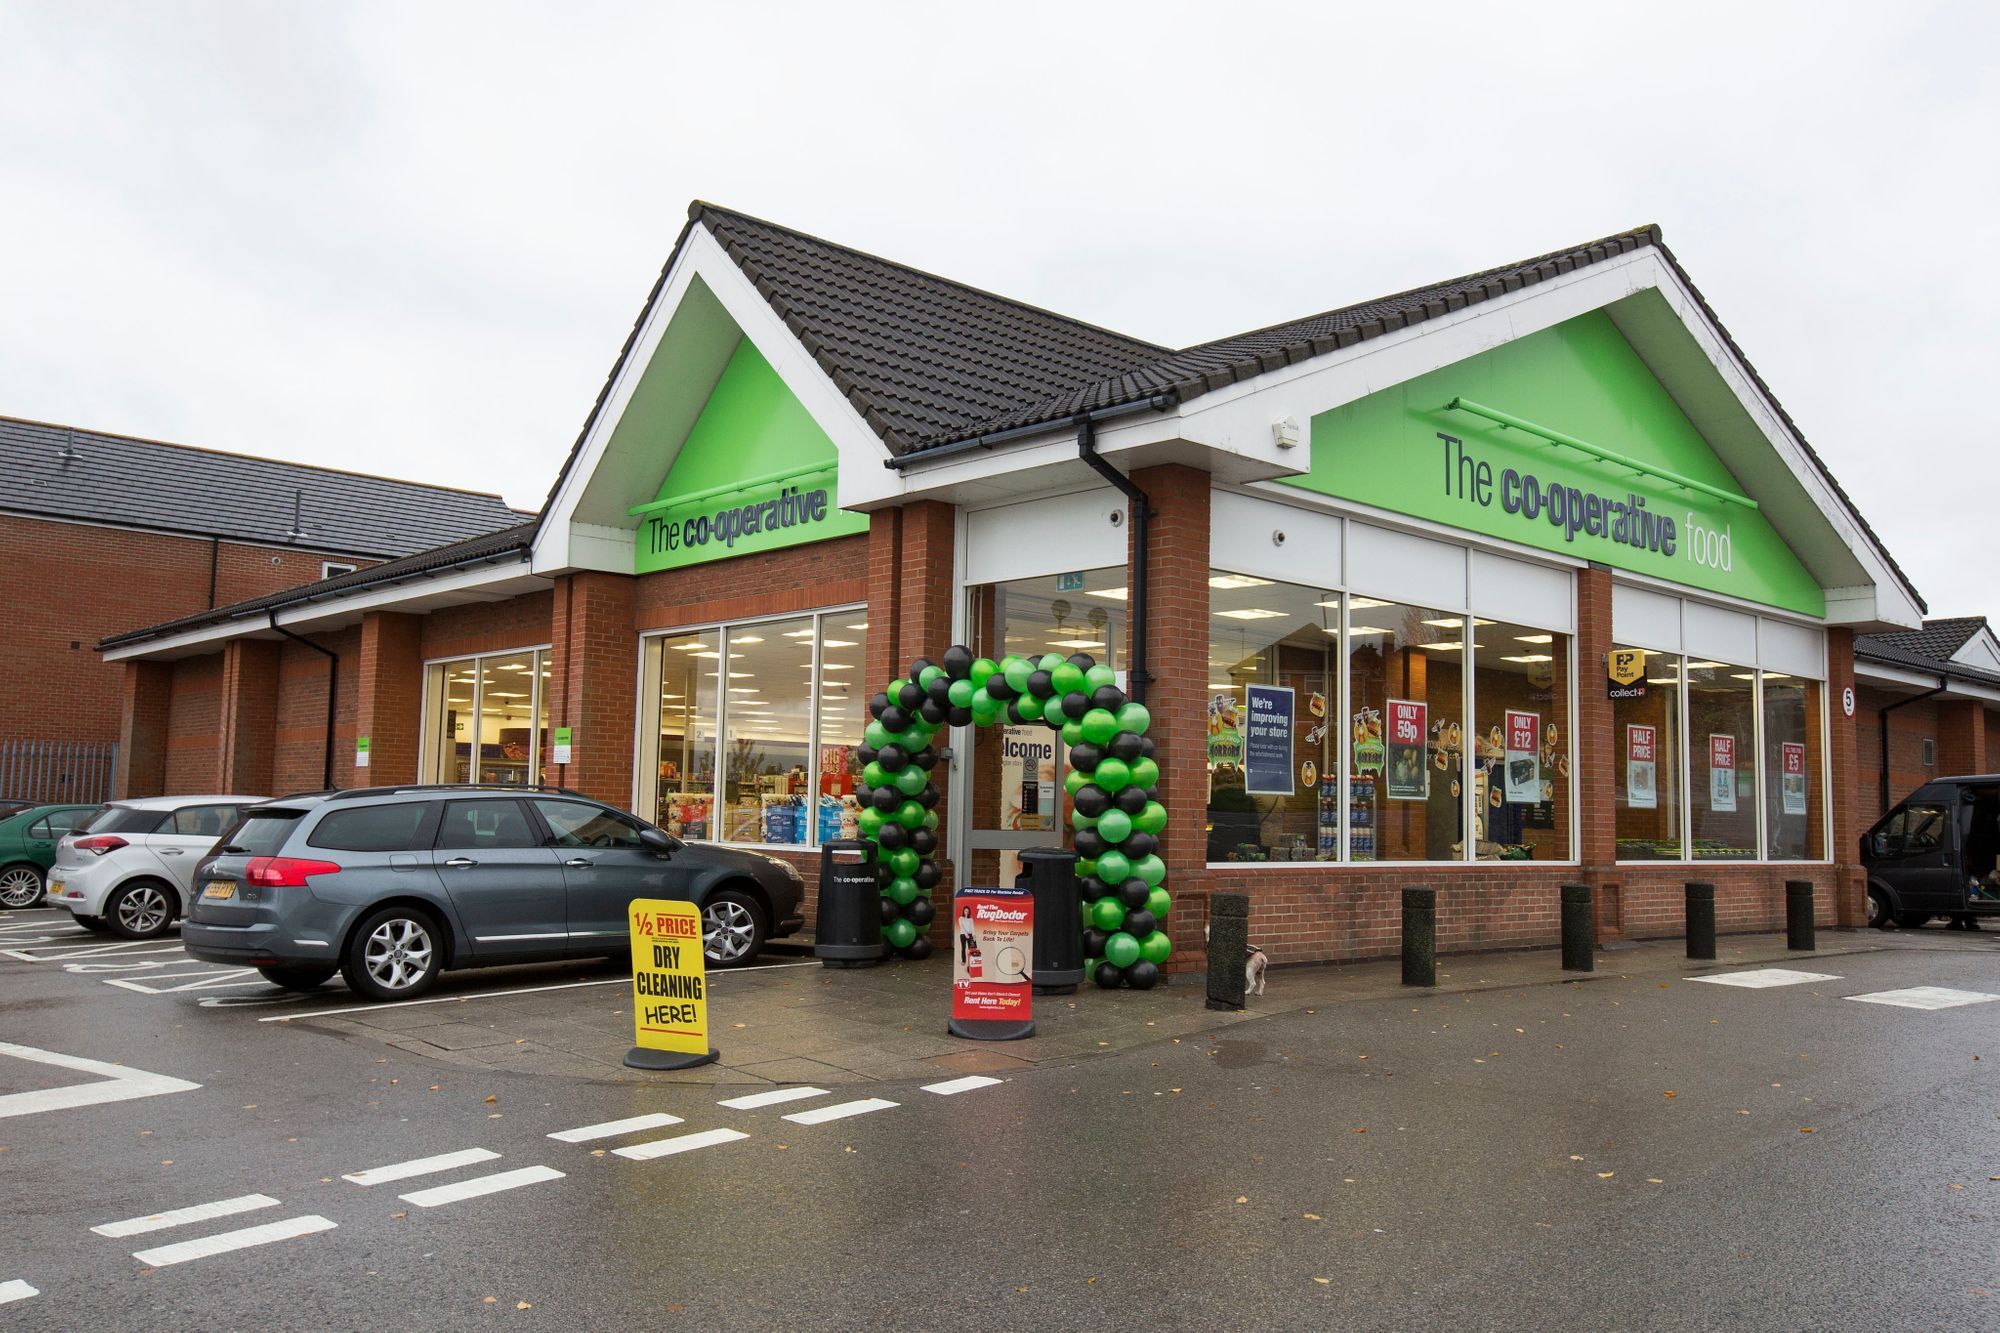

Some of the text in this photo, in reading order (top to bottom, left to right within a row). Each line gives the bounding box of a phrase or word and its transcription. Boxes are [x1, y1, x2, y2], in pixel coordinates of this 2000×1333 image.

[1436, 431, 1733, 573] The co-operative food
[648, 485, 828, 554] The co-operative
[1251, 696, 1273, 709] We're
[1845, 690, 1852, 707] 5
[1251, 710, 1288, 727] improving
[1397, 704, 1418, 720] ONLY
[1514, 715, 1532, 729] ONLY
[696, 730, 702, 739] 2
[729, 729, 733, 738] 1
[1004, 727, 1021, 736] erative
[1250, 726, 1288, 738] your store
[1397, 720, 1418, 743] 59p
[1632, 729, 1651, 744] HALF
[1514, 730, 1531, 749] £12
[1714, 738, 1731, 752] HALF
[1004, 737, 1052, 759] lcome
[1632, 745, 1651, 759] PRICE
[822, 749, 840, 764] BIG
[1714, 753, 1731, 766] PRICE
[1788, 753, 1799, 771] £5
[843, 876, 875, 884] co-operative
[656, 916, 697, 936] PRICE
[652, 944, 681, 970] DRY
[636, 971, 703, 1001] CLEANING
[964, 996, 1021, 1007] Rent Here Today!
[644, 1003, 698, 1025] HERE!
